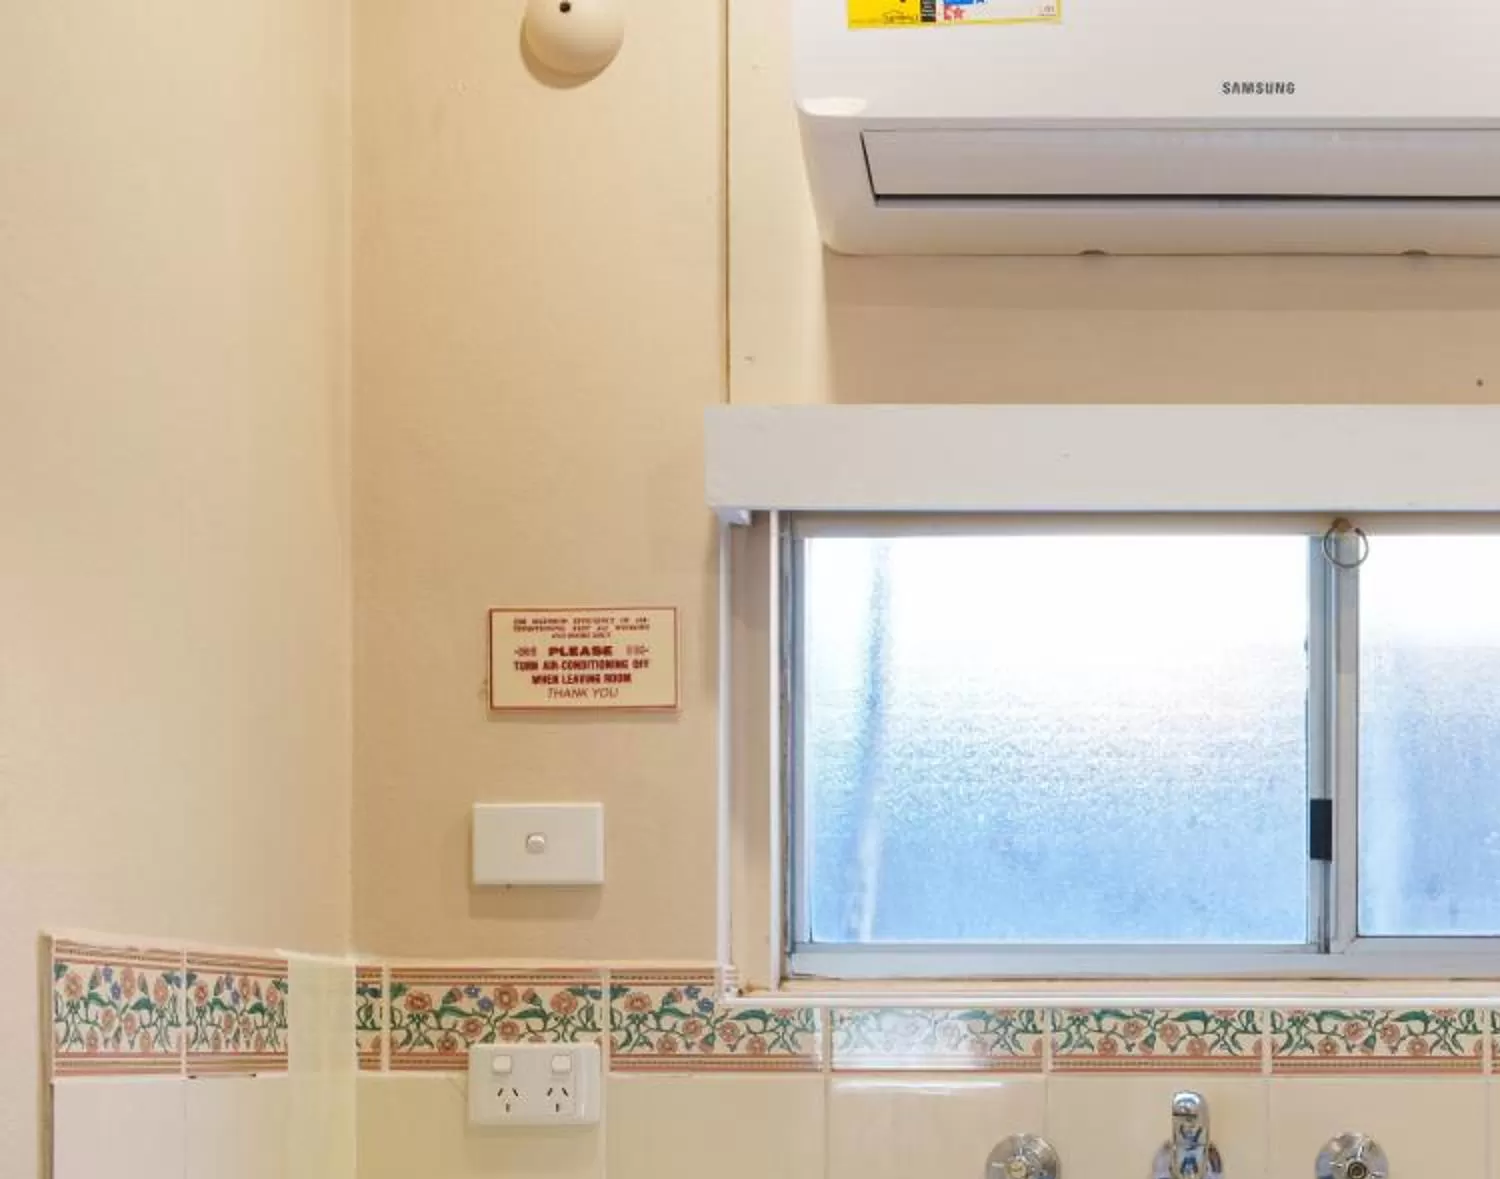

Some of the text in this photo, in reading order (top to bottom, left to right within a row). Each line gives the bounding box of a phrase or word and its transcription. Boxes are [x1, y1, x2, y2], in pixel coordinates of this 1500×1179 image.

[1222, 81, 1295, 95] SAMSUNG
[548, 645, 613, 657] PLEASE
[547, 687, 619, 699] THANK YOU
